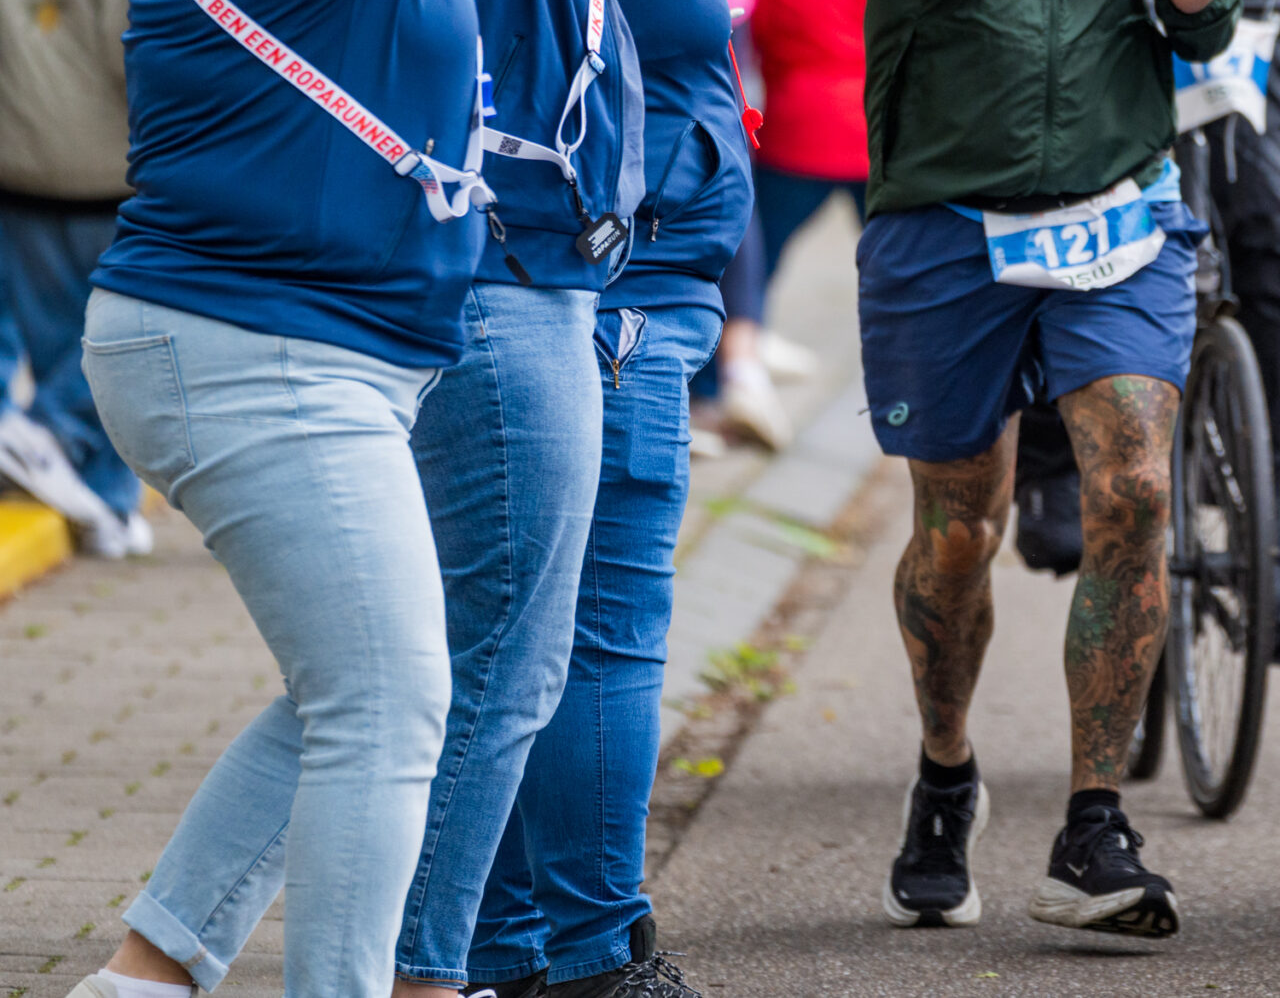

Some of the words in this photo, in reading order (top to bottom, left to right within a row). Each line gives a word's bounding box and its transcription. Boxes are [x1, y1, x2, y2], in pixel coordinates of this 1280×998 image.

[592, 13, 601, 37] IK
[244, 30, 288, 66] EEN
[283, 60, 404, 161] ROPARUNNER
[593, 229, 620, 259] ROPARUN
